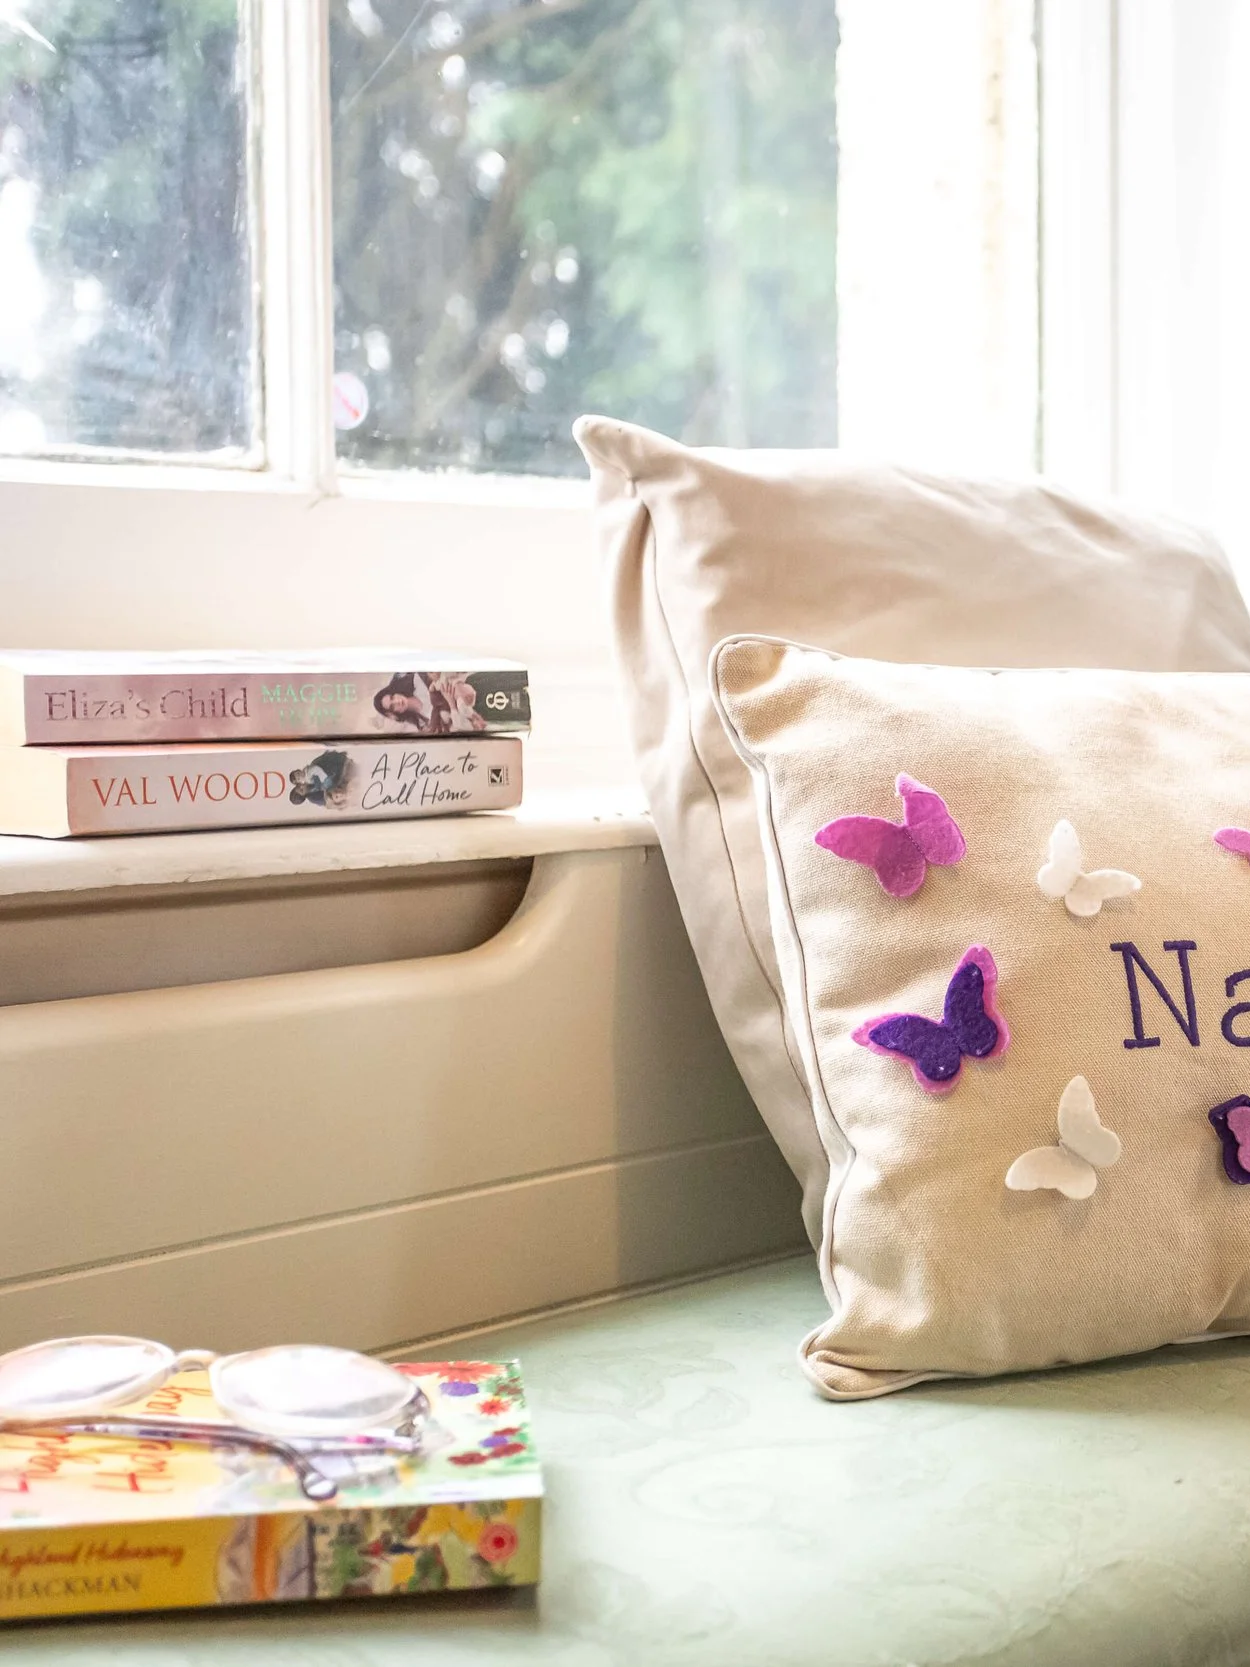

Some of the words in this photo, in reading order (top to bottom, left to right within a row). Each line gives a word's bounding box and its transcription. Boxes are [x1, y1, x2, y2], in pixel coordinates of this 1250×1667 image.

[44, 688, 150, 721] Eliza's
[159, 686, 250, 719] Child
[261, 683, 358, 703] MAGGIE
[371, 752, 391, 780] A
[397, 751, 454, 780] Place
[457, 751, 478, 775] to
[91, 776, 157, 807] VAL
[168, 770, 286, 802] WOOD
[361, 780, 417, 810] Call
[420, 777, 472, 806] Home
